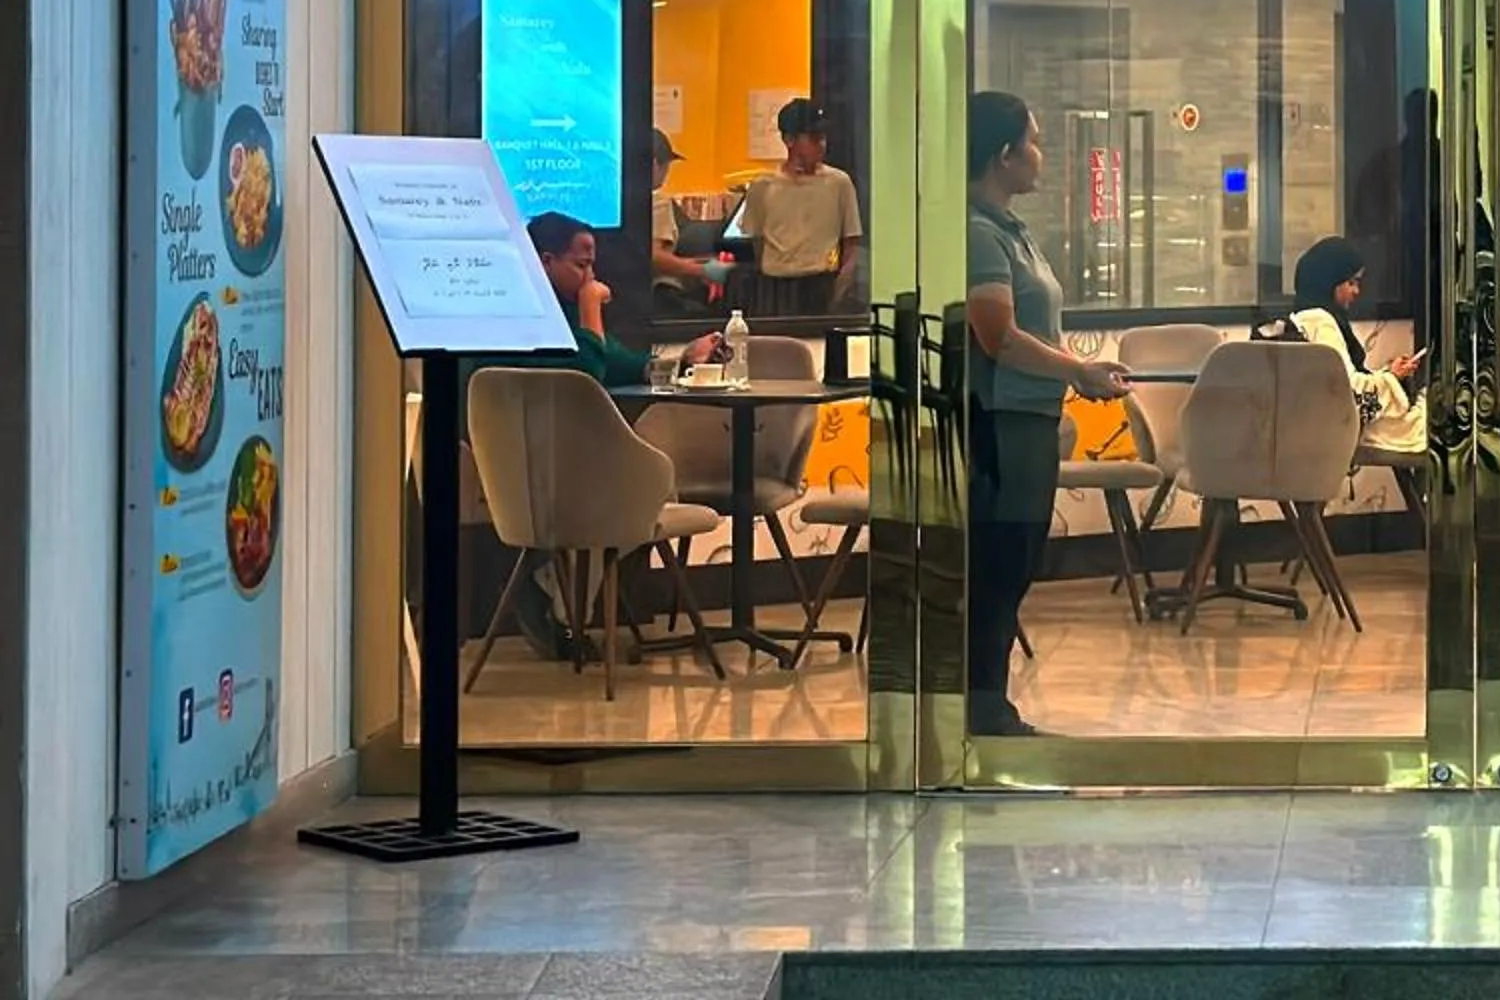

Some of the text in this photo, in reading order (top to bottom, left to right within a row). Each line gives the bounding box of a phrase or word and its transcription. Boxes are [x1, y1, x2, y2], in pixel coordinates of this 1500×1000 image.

[242, 10, 277, 61] Sharing
[161, 188, 202, 249] Single
[167, 244, 216, 282] Platters
[229, 337, 259, 394] Easy
[257, 365, 283, 422] EATS
